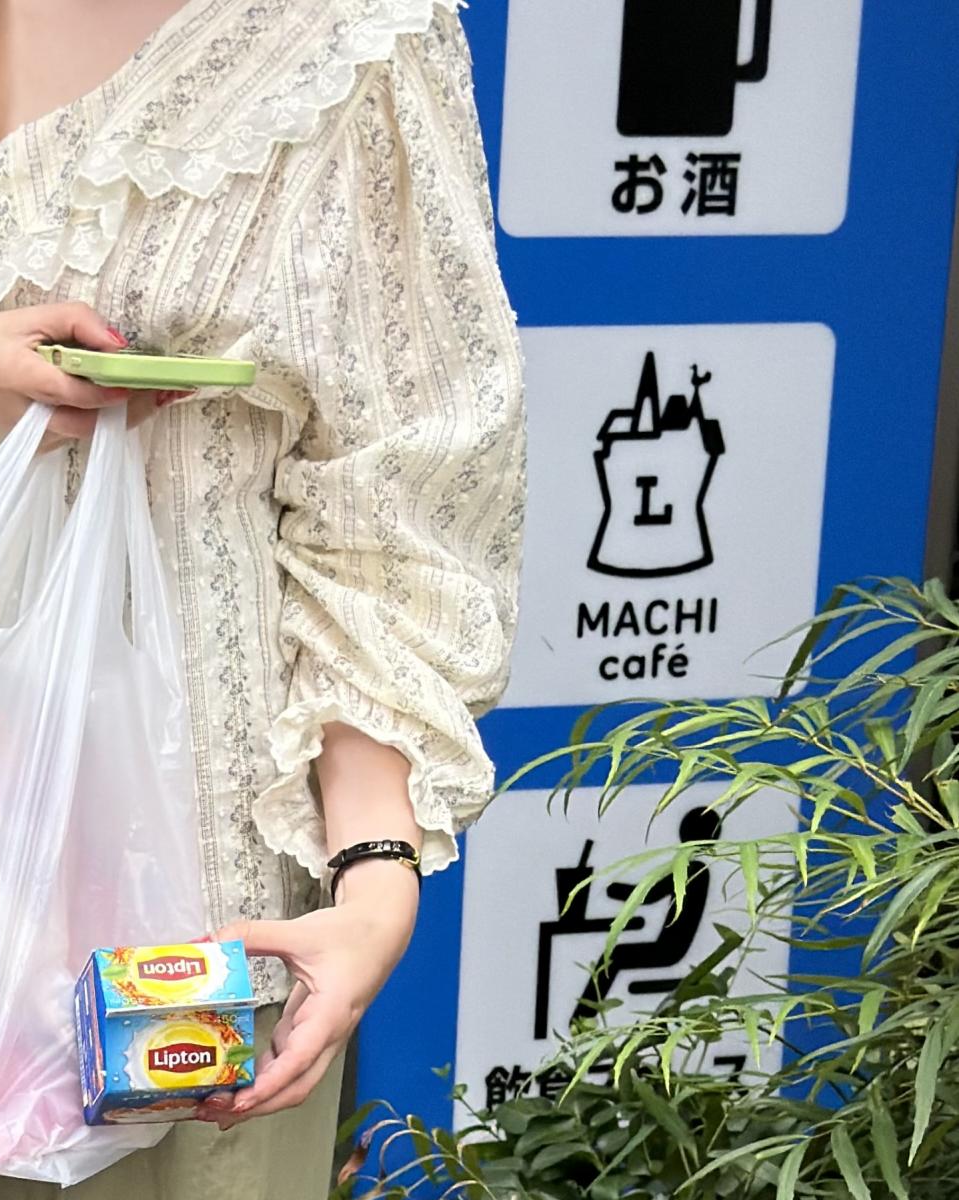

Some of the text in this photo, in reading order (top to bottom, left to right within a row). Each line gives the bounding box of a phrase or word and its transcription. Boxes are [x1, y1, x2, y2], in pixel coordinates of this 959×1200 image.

[611, 151, 742, 217] お酒
[633, 475, 673, 527] L
[576, 597, 718, 639] MACHI
[598, 642, 689, 681] café
[143, 959, 202, 975] Lipton
[153, 1049, 211, 1069] Lipton
